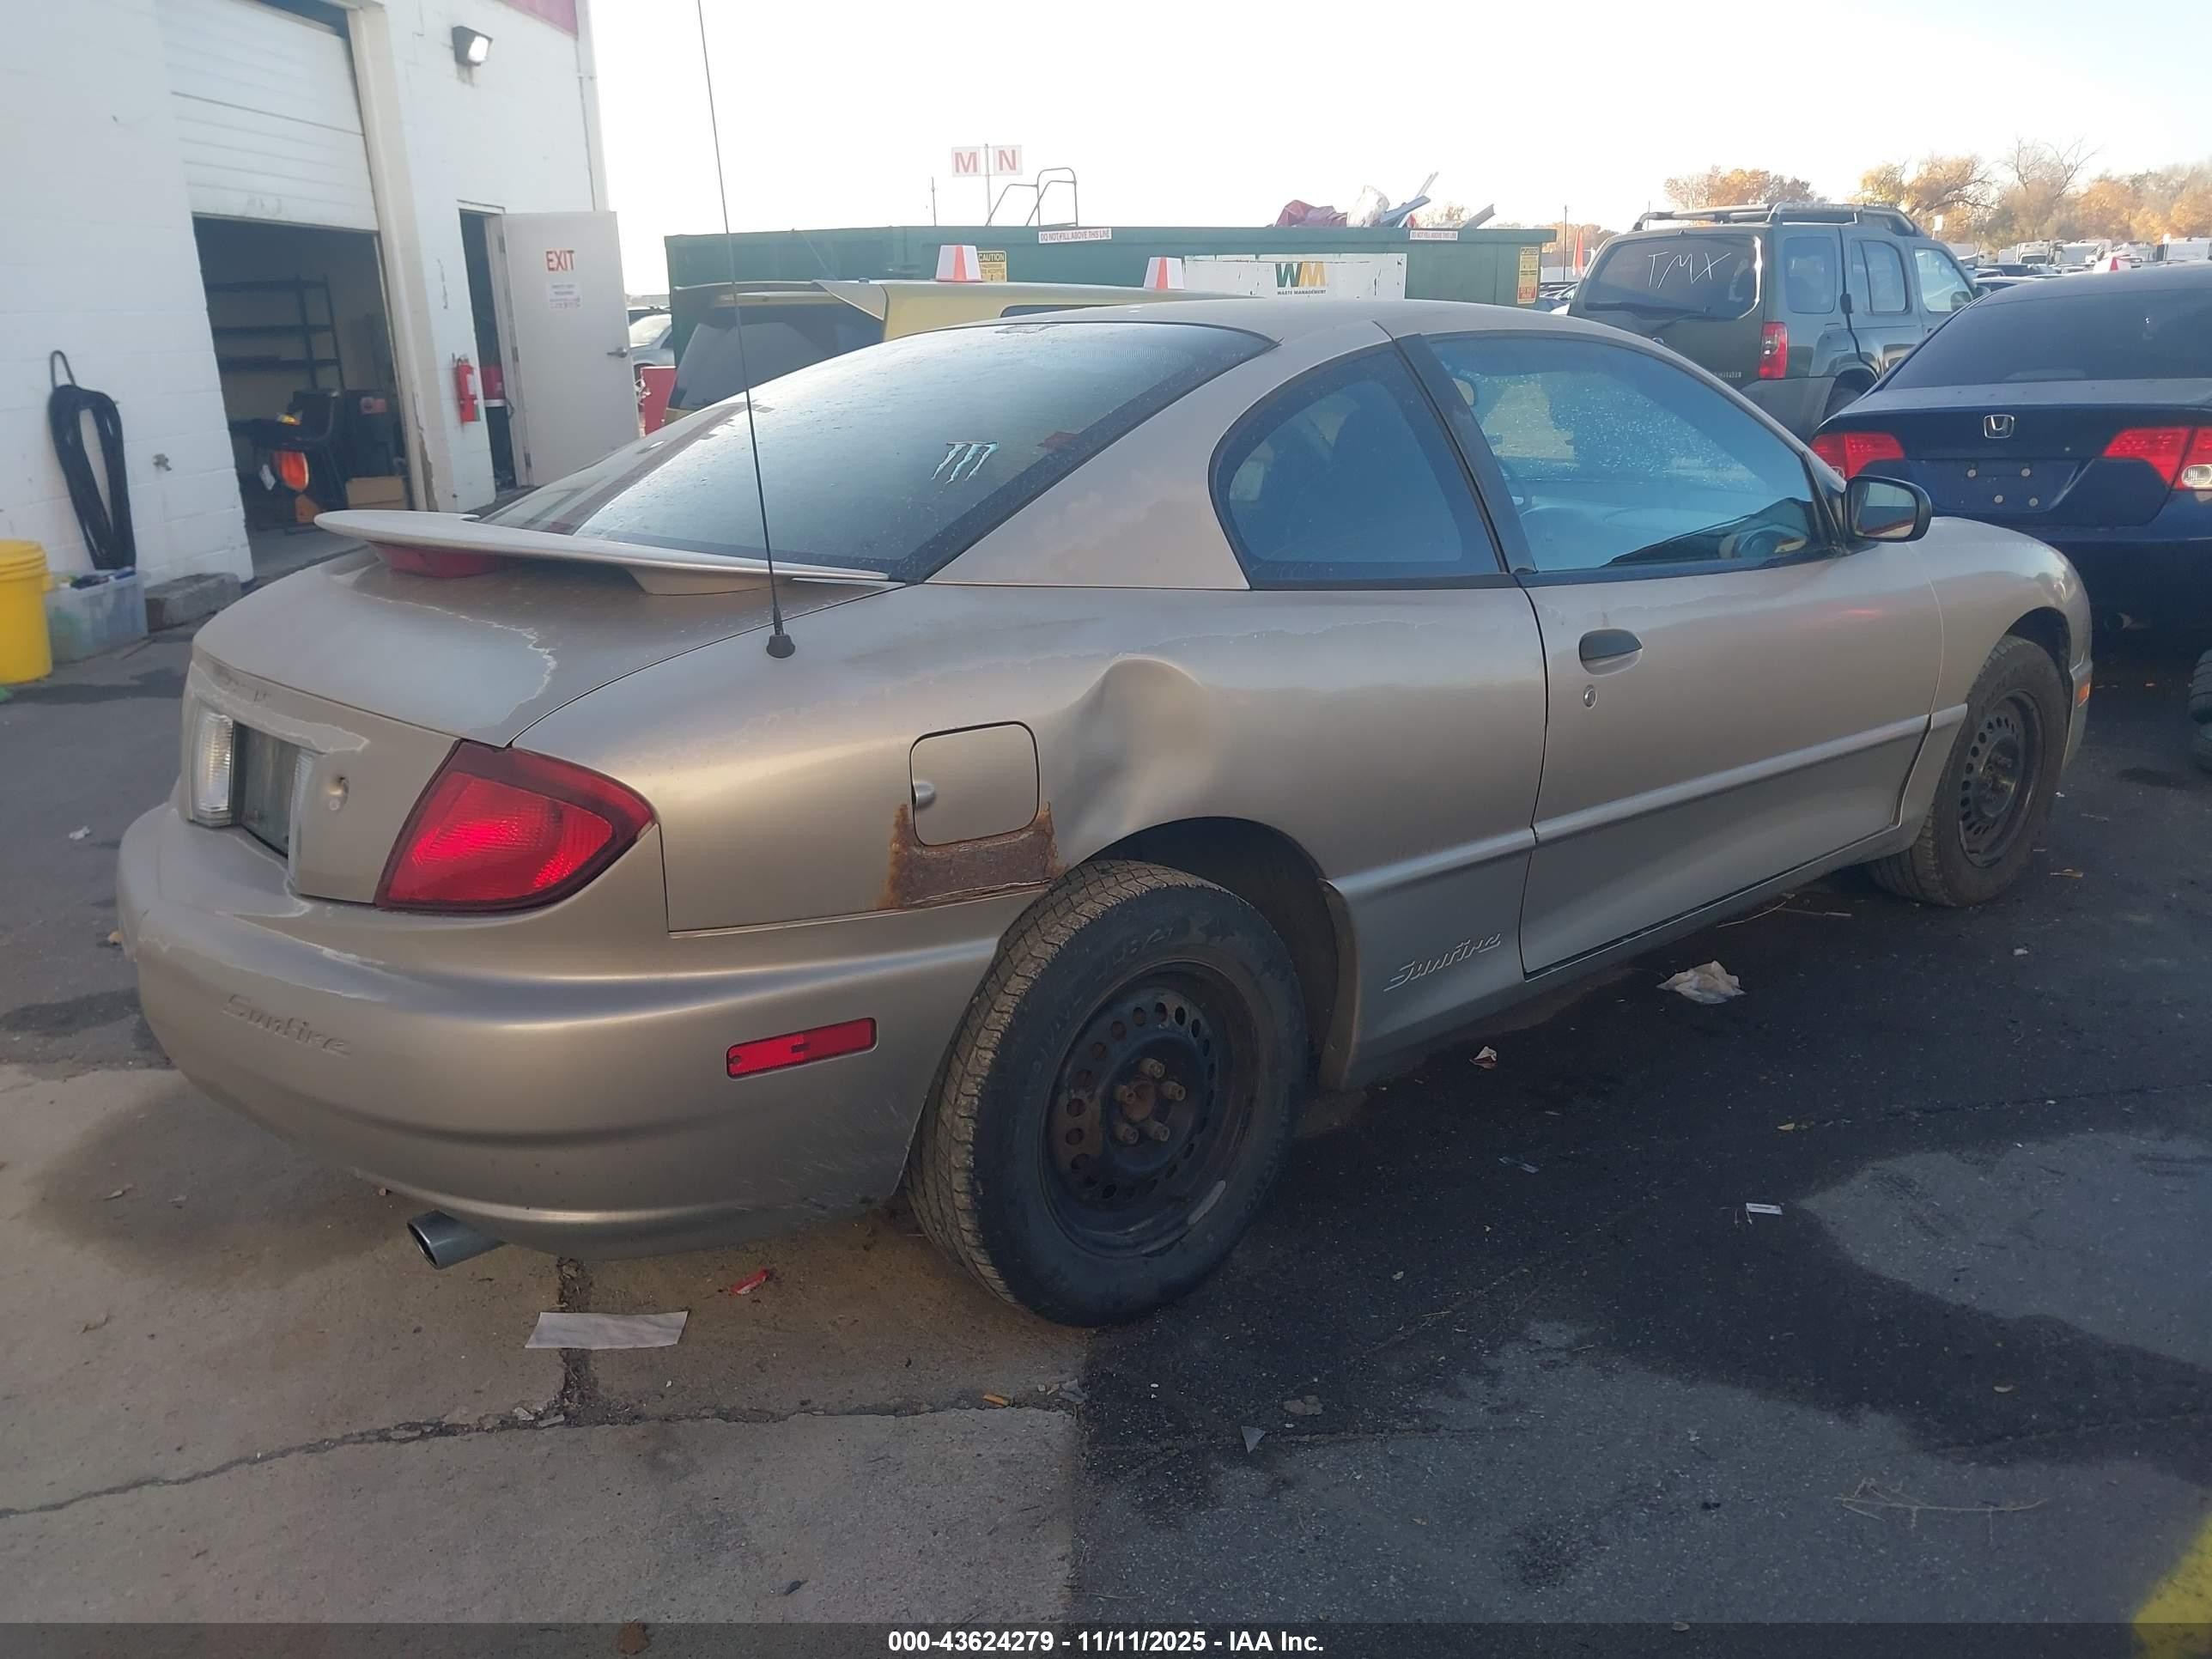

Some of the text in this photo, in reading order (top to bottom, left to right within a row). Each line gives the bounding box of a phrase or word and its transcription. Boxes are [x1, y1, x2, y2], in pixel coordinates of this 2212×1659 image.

[954, 151, 978, 173] M
[998, 149, 1017, 171] N
[1040, 233, 1048, 241] DO
[545, 249, 574, 271] EXIT
[978, 253, 1005, 262] CAUTION
[1274, 262, 1327, 288] WM
[1648, 250, 1731, 289] TMX
[1382, 933, 1502, 992] Sunfire
[220, 994, 352, 1057] Sunfire
